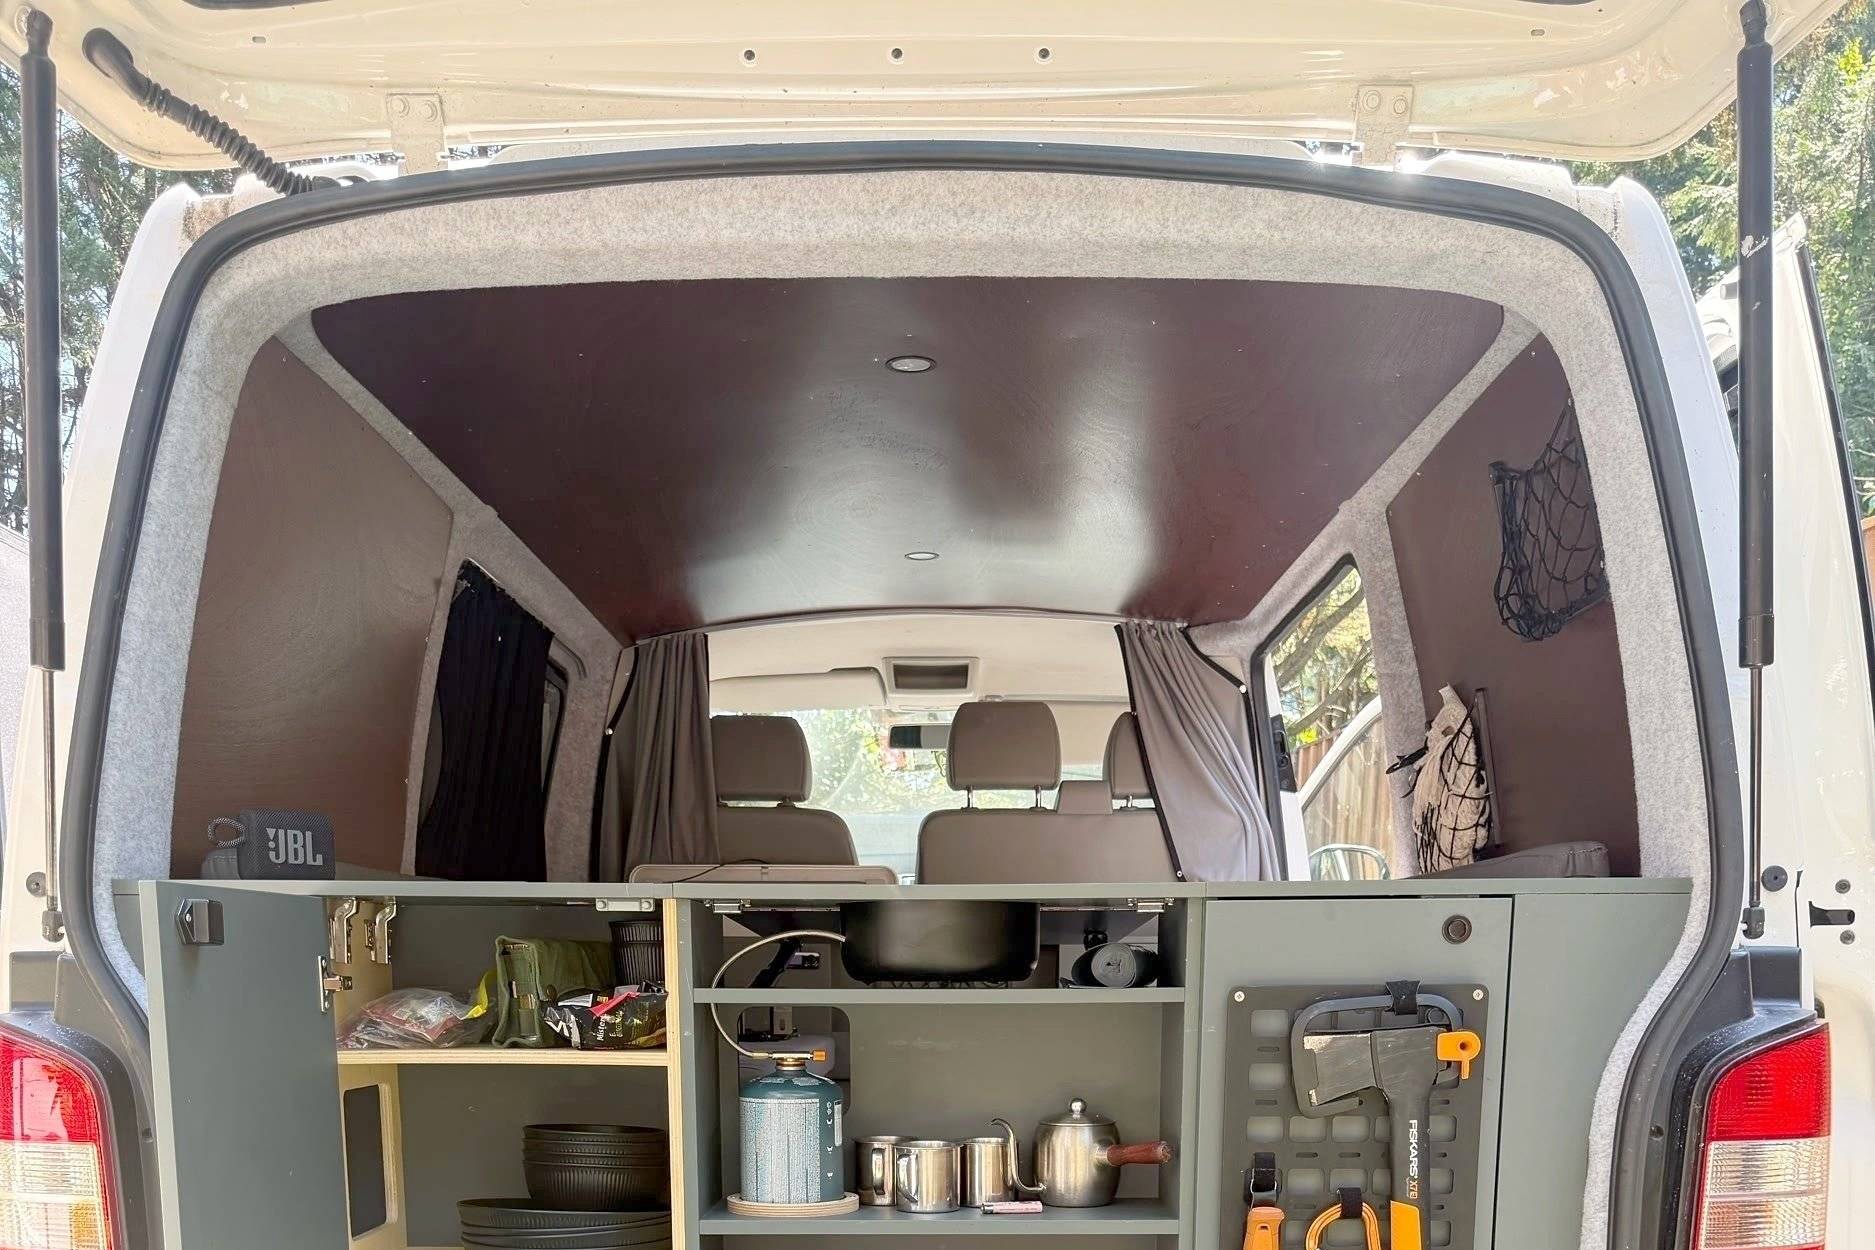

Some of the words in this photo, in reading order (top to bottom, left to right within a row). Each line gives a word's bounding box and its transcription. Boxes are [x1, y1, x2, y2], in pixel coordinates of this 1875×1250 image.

[267, 828, 323, 866] JBL
[1409, 1119, 1418, 1178] FISKARS
[1409, 1180, 1418, 1191] X7
